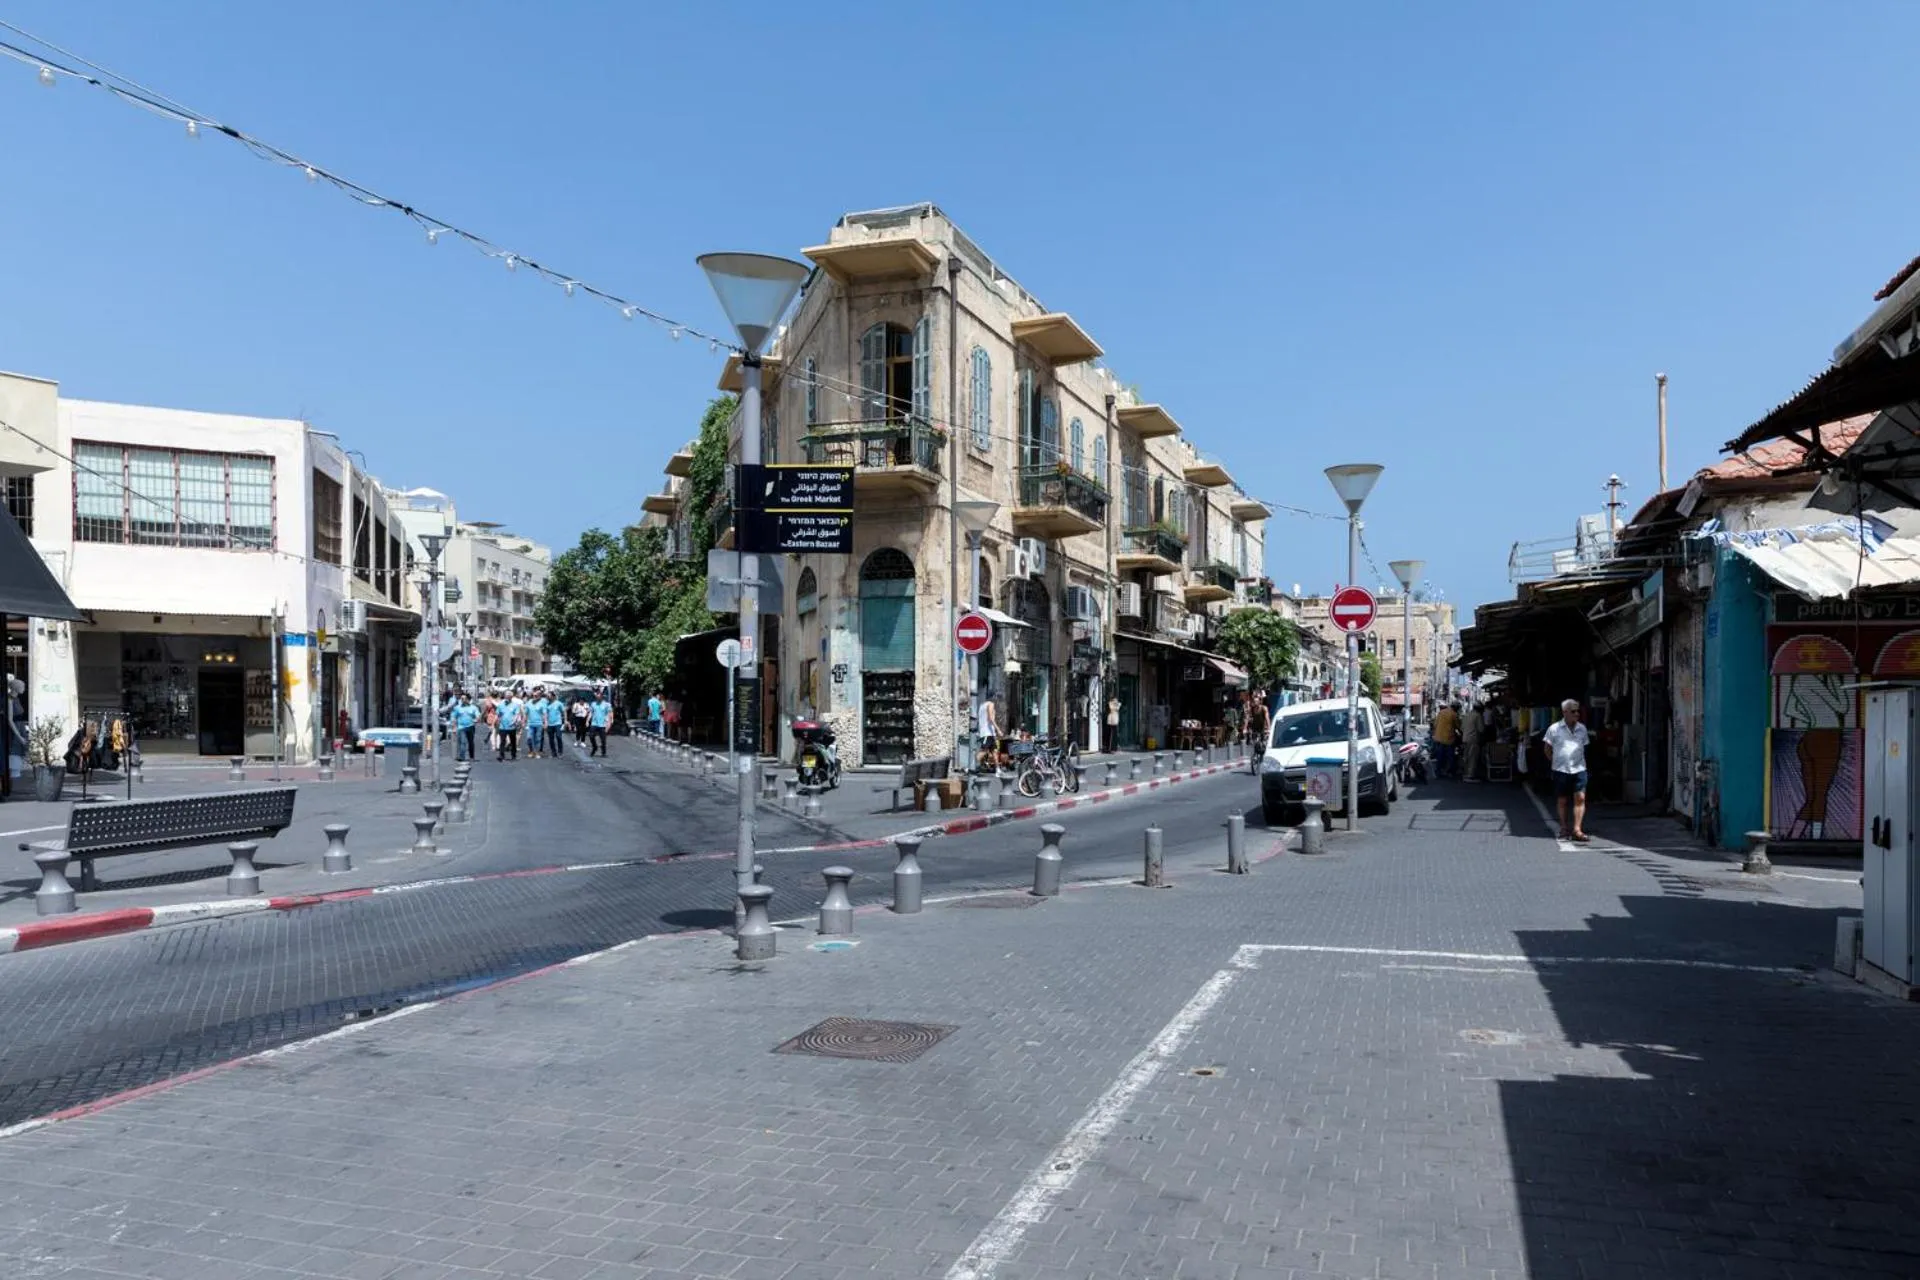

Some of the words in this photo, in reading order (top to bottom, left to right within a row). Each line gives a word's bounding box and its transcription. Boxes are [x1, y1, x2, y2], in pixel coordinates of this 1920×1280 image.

[819, 472, 841, 481] השוק
[818, 483, 841, 493] السوق
[791, 495, 813, 503] Greek
[814, 495, 841, 503] Market
[788, 517, 815, 525] המזרחי
[816, 517, 840, 525] הבזאר
[817, 528, 840, 538] السوق
[787, 540, 815, 548] Eastern
[815, 540, 840, 548] Bazaar
[1798, 600, 1896, 619] perfumry
